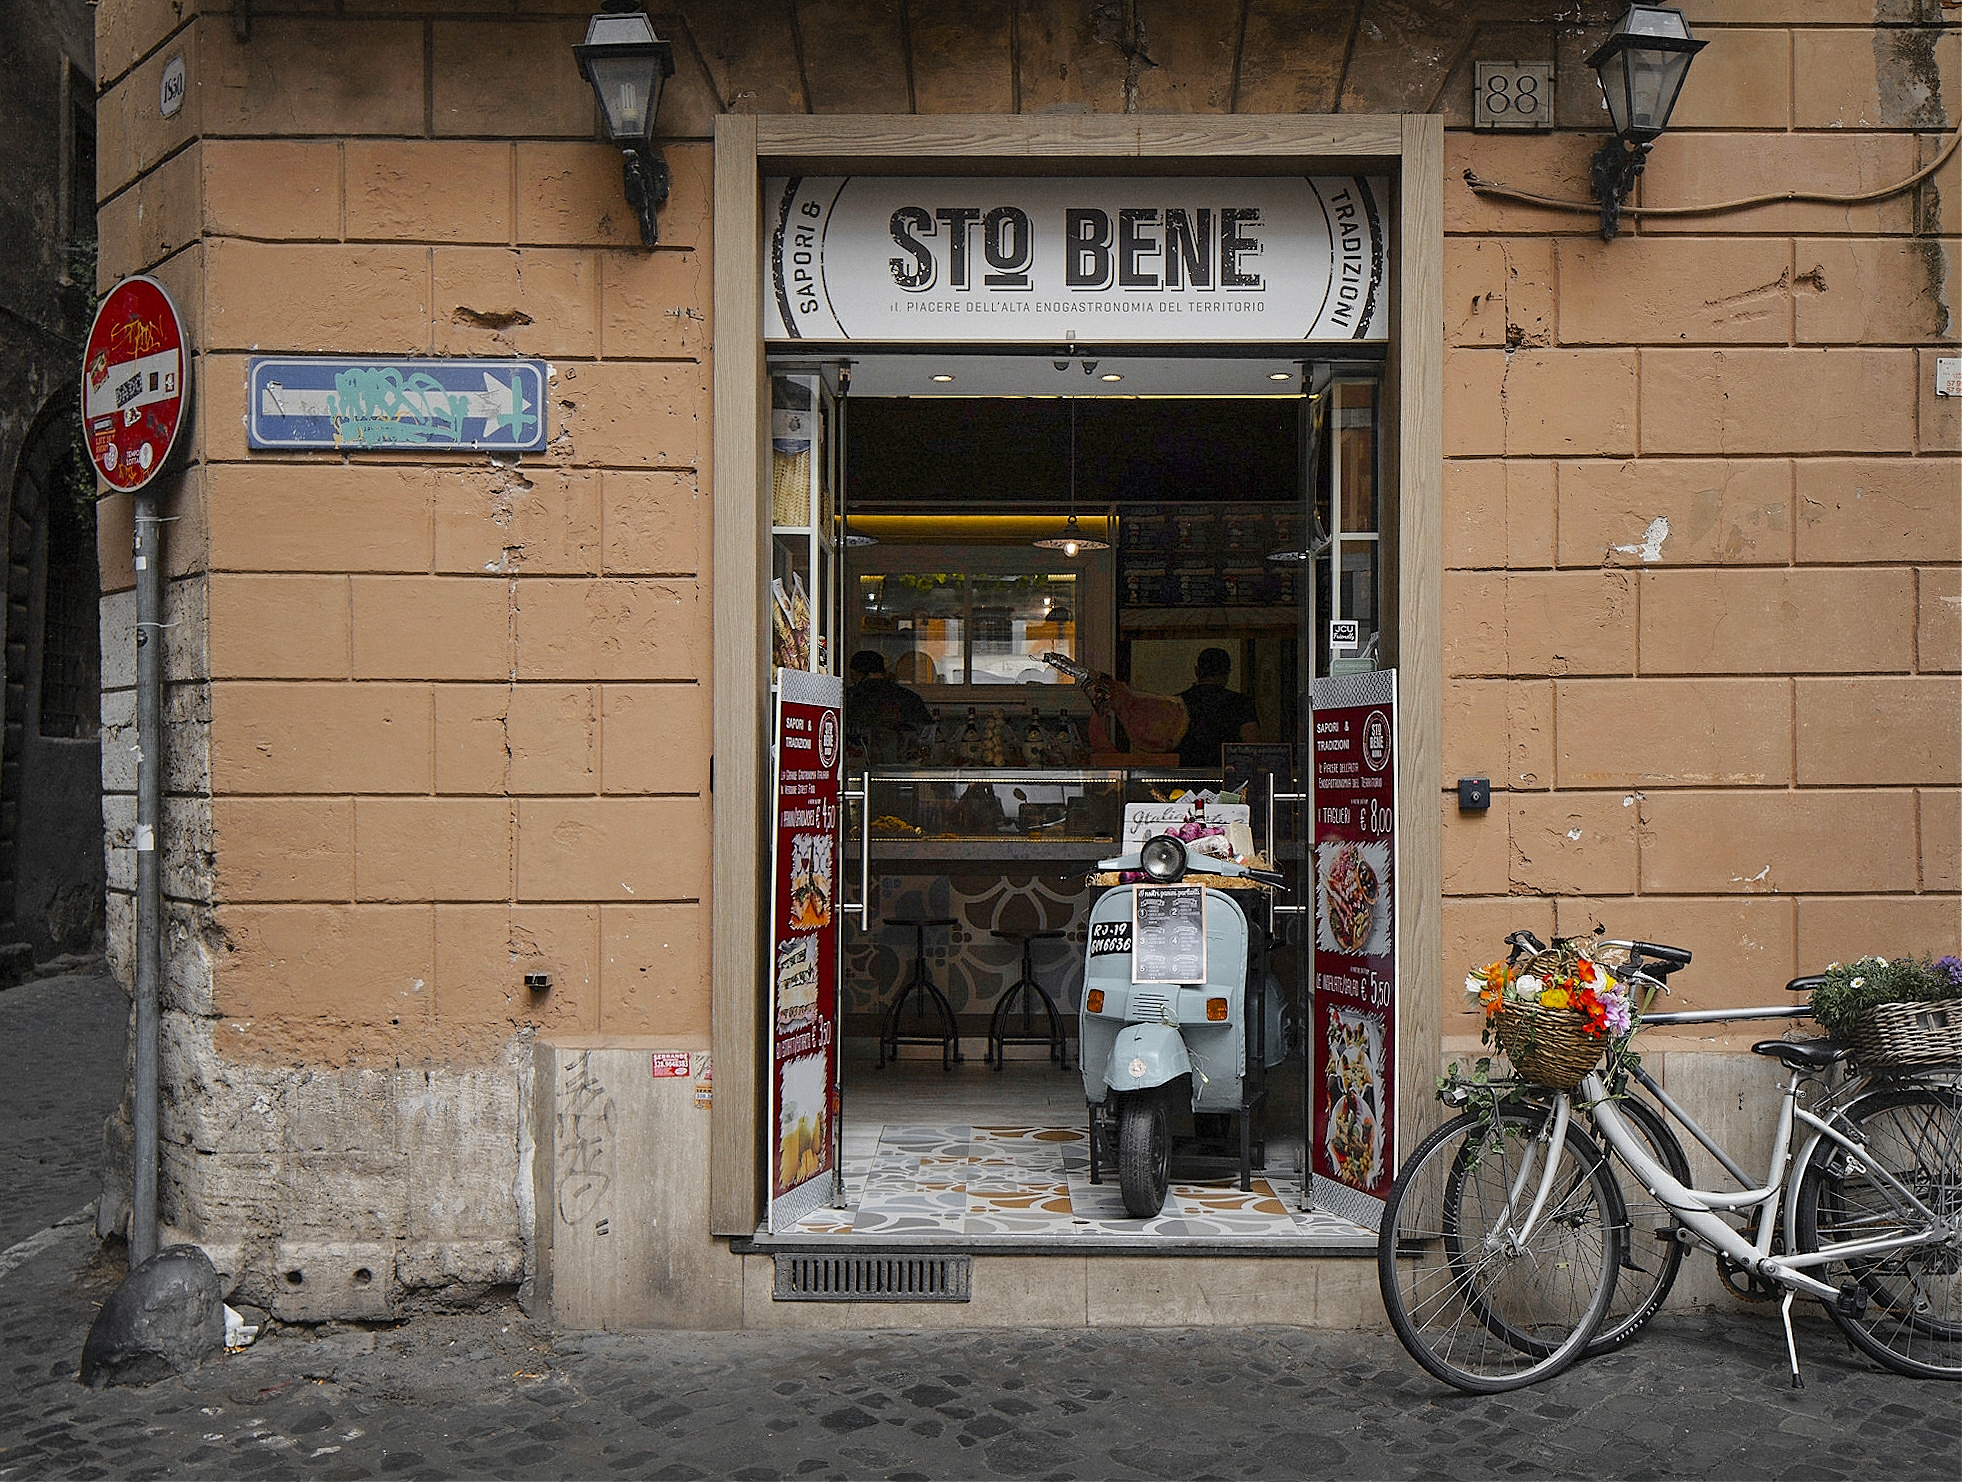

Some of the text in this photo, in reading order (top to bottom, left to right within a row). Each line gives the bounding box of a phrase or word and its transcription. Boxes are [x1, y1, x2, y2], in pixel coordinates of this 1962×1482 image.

[1486, 75, 1538, 113] 88
[793, 200, 821, 314] SAPORI &
[889, 206, 1266, 292] STO BENE
[1330, 187, 1362, 328] TRADIZIONI
[907, 302, 960, 312] PIACERE
[966, 302, 1030, 312] DELL'ALTA
[1035, 302, 1154, 313] ENOGASTRONOMIA
[1159, 302, 1182, 312] DEL
[1188, 302, 1265, 313] TERRITORIO
[1334, 625, 1354, 633] JCU
[786, 717, 812, 732] SAPORI &
[1316, 720, 1350, 733] SAPORI &
[1317, 739, 1350, 751] TRADIZIONI
[1369, 735, 1384, 749] BENE
[1323, 807, 1351, 824] TAGLIERI
[1360, 807, 1367, 831] €
[1370, 798, 1393, 836] 8,00
[1361, 977, 1367, 1001] €
[1370, 971, 1391, 1008] 5,50
